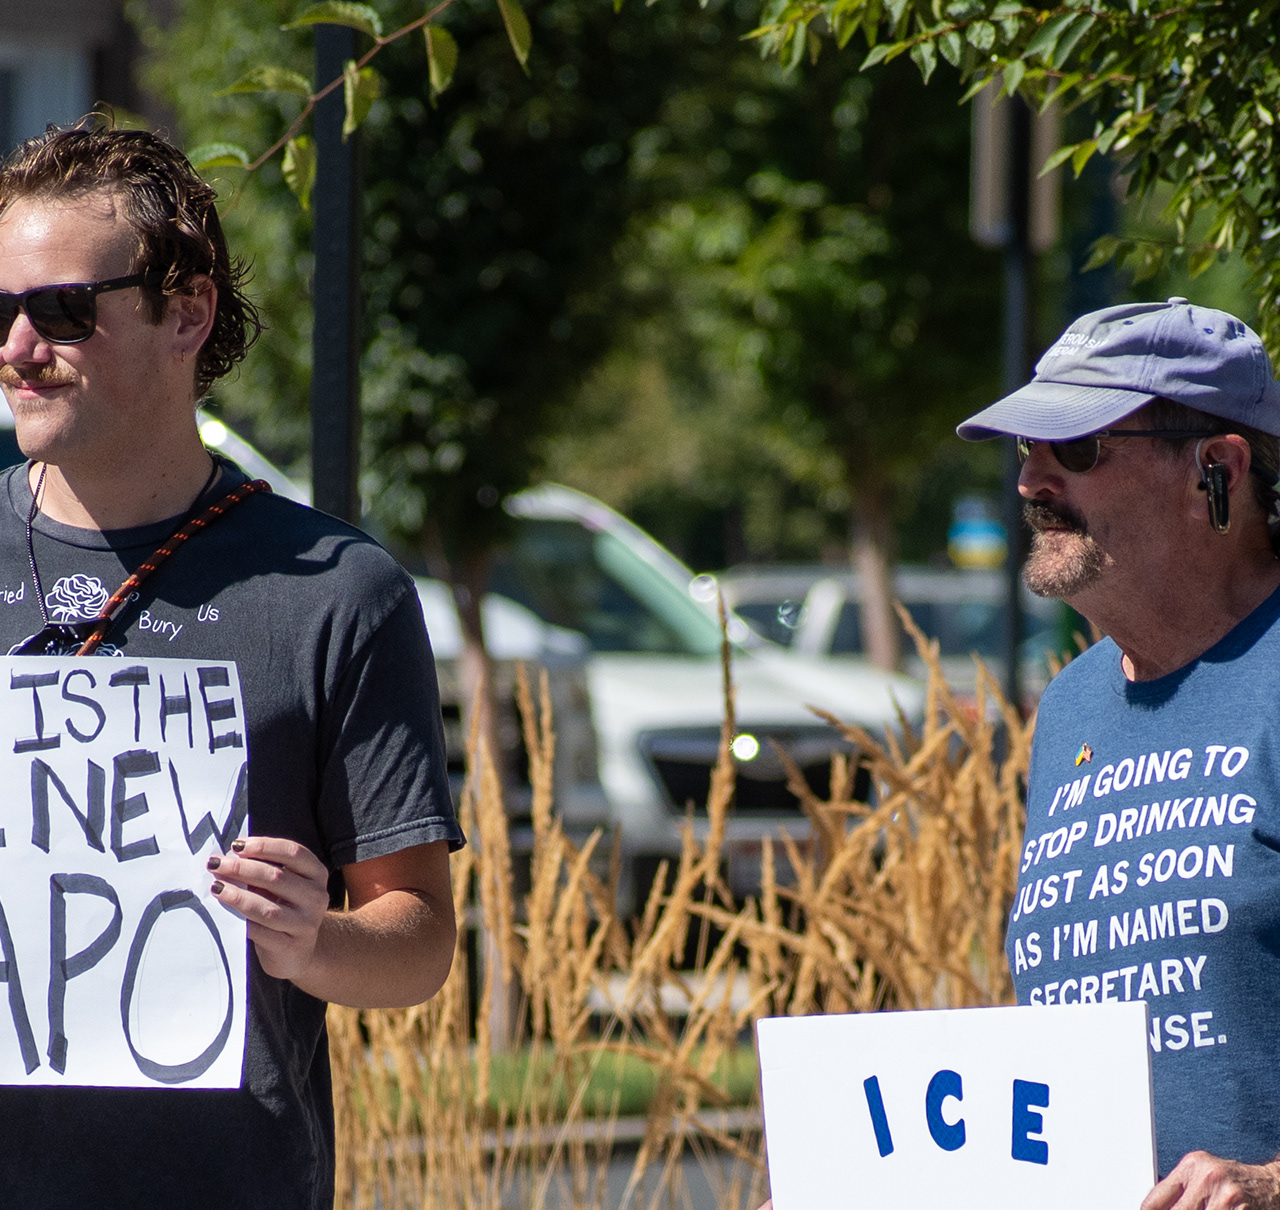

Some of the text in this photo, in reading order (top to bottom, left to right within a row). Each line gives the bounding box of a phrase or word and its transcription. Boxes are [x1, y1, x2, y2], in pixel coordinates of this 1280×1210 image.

[139, 610, 183, 641] Bury
[197, 604, 220, 622] Us
[10, 668, 107, 753] IS
[109, 665, 245, 754] THE
[29, 749, 248, 862] NEW
[1048, 744, 1250, 817] I'M GOING TO
[1021, 793, 1257, 874] STOP DRINKING
[1013, 844, 1236, 922] JUST AS SOON
[1014, 898, 1229, 975] AS I'M NAMED
[1029, 954, 1207, 1007] SECRETARY
[863, 1069, 1050, 1166] ICE
